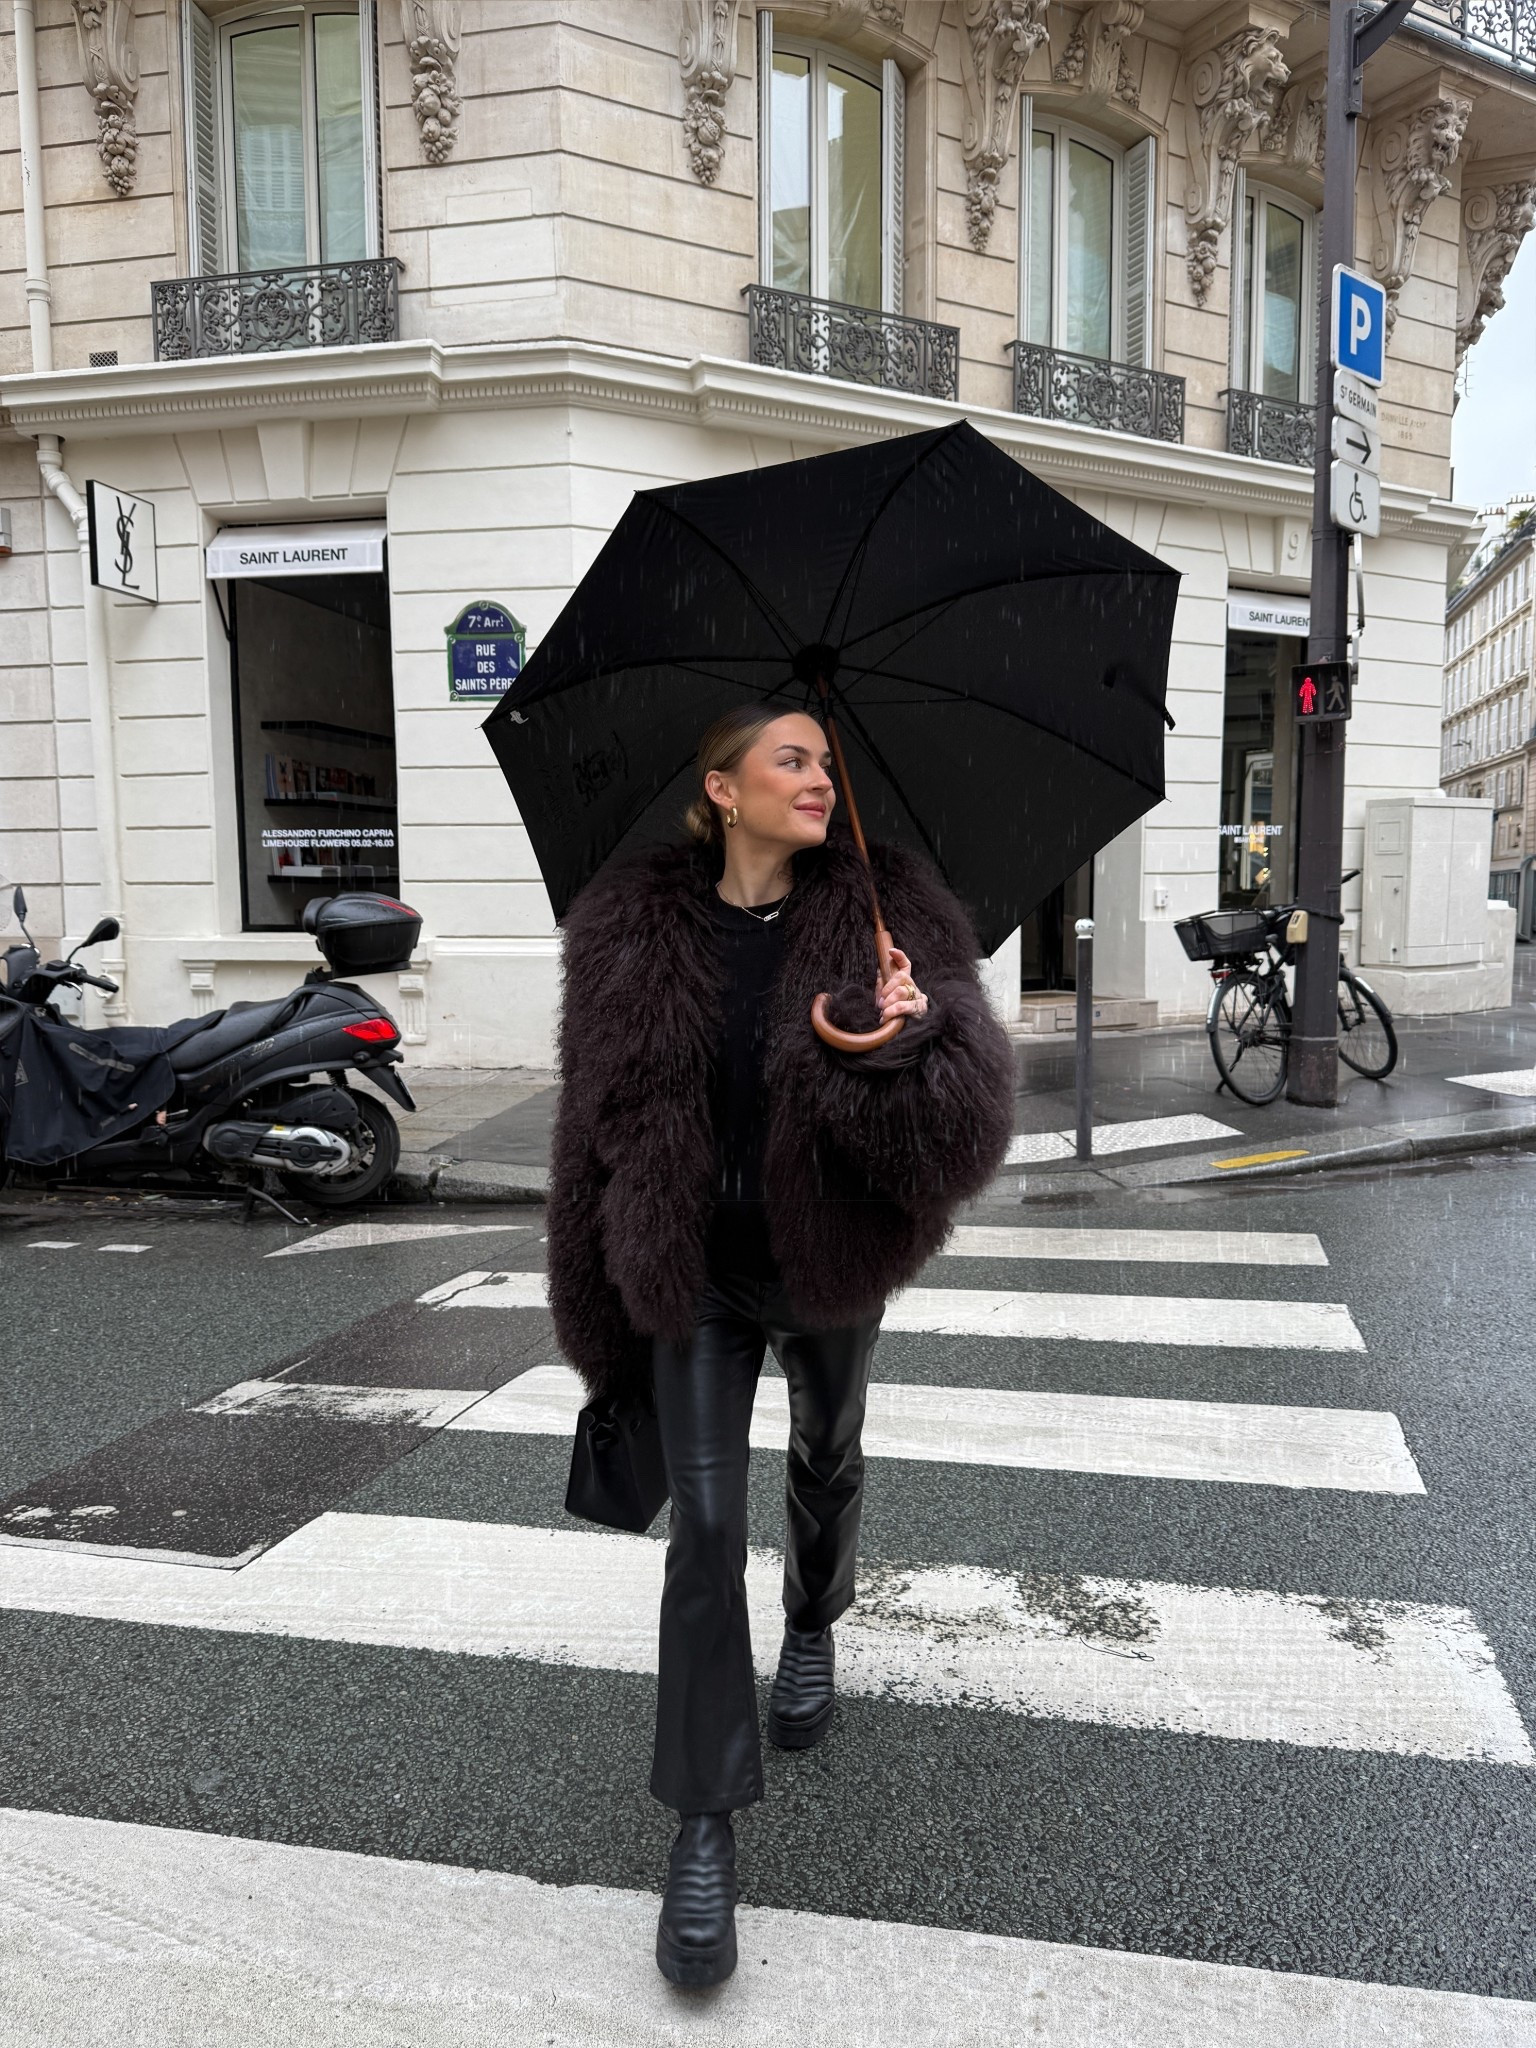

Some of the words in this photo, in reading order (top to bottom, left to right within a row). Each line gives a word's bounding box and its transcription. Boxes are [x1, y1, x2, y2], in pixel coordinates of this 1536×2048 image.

[1350, 293, 1372, 355] P
[1348, 389, 1377, 418] GERMAIN
[114, 495, 141, 590] YSL
[1287, 530, 1299, 561] 9
[239, 551, 279, 565] SAINT
[282, 547, 348, 564] LAURENT
[1248, 611, 1274, 624] SAINT
[475, 644, 496, 657] RUE
[477, 661, 496, 674] DES
[455, 678, 488, 691] SAINTS
[262, 829, 317, 838] ALESSANDRO
[318, 829, 362, 838] FURCHINO
[363, 829, 394, 838] CAPRIA
[1242, 824, 1283, 836] LAURENT
[262, 838, 310, 848] LIMEHOUSE
[310, 838, 351, 848] FLOWERS
[350, 838, 395, 848] 05.02-16.03
